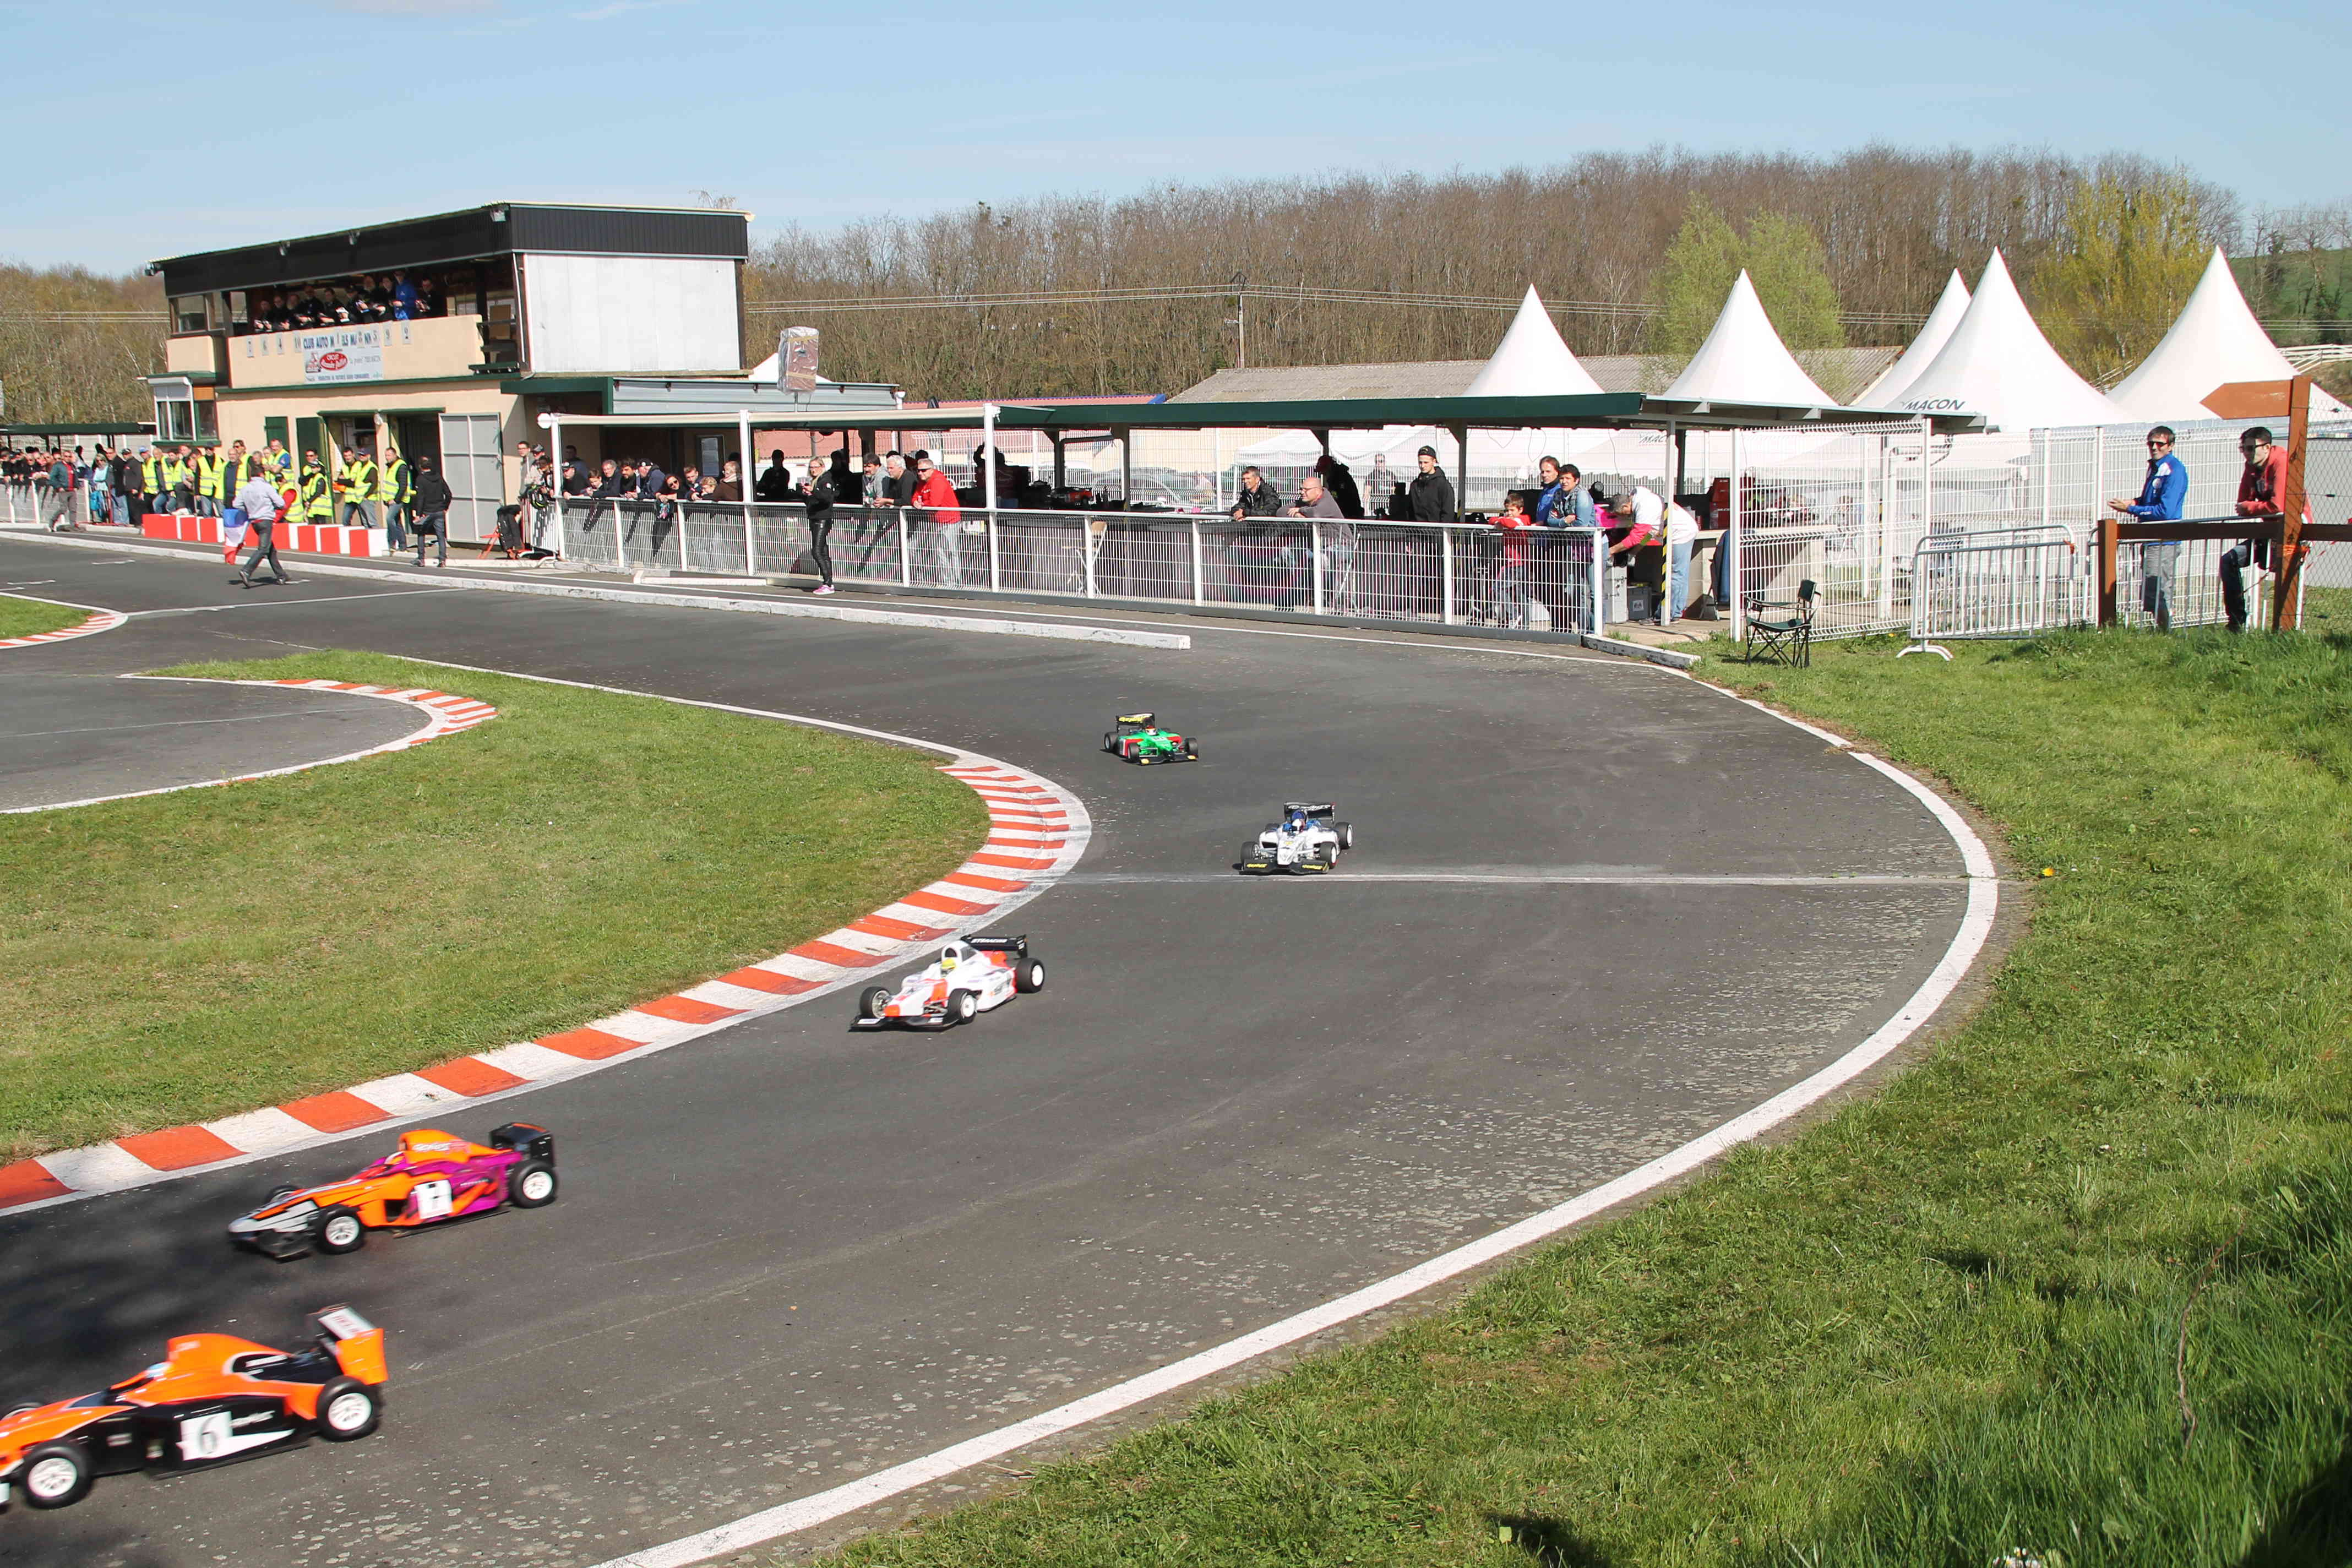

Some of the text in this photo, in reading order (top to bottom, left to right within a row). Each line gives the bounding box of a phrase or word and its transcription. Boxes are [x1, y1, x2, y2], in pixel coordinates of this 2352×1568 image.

[303, 337, 314, 349] CLUB
[317, 336, 328, 348] AUTO
[1638, 435, 1667, 443] MAC
[198, 1415, 219, 1455] 6
